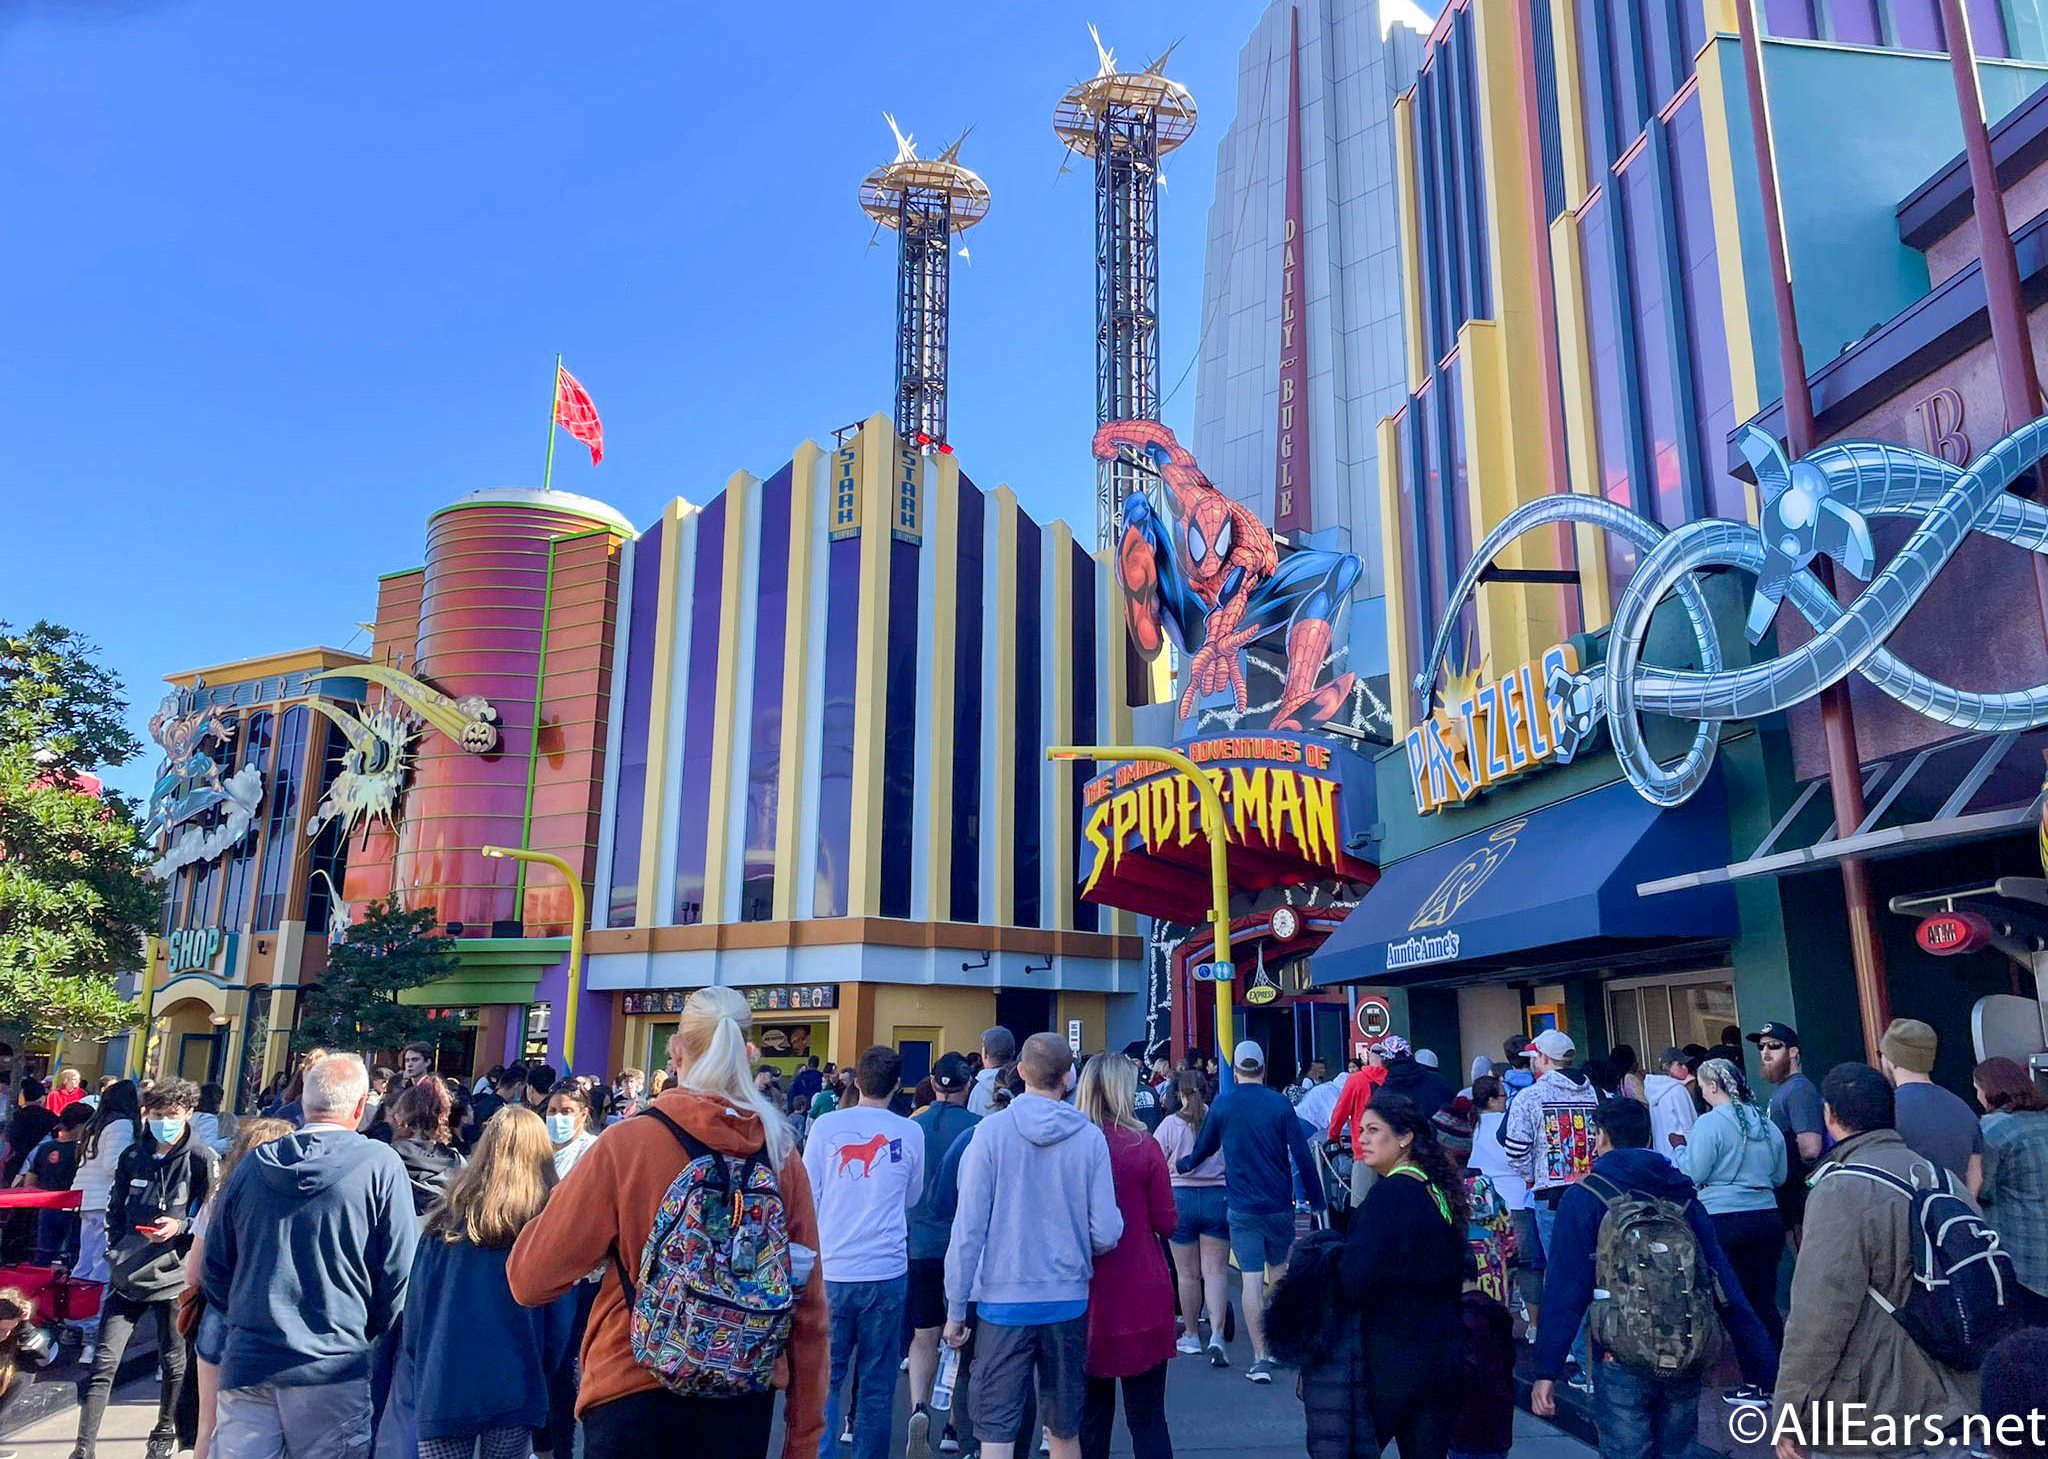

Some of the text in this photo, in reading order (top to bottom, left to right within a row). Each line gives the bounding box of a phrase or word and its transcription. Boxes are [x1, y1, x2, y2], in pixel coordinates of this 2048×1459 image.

[1279, 219, 1298, 517] DAILY BUGLE
[1083, 775, 1111, 806] THE
[1189, 738, 1299, 764] ADVENTURES
[1306, 744, 1328, 768] OF
[1080, 767, 1342, 900] SPIDER-MAN
[167, 928, 220, 973] SHOP
[1249, 990, 1274, 1002] EXPRESS
